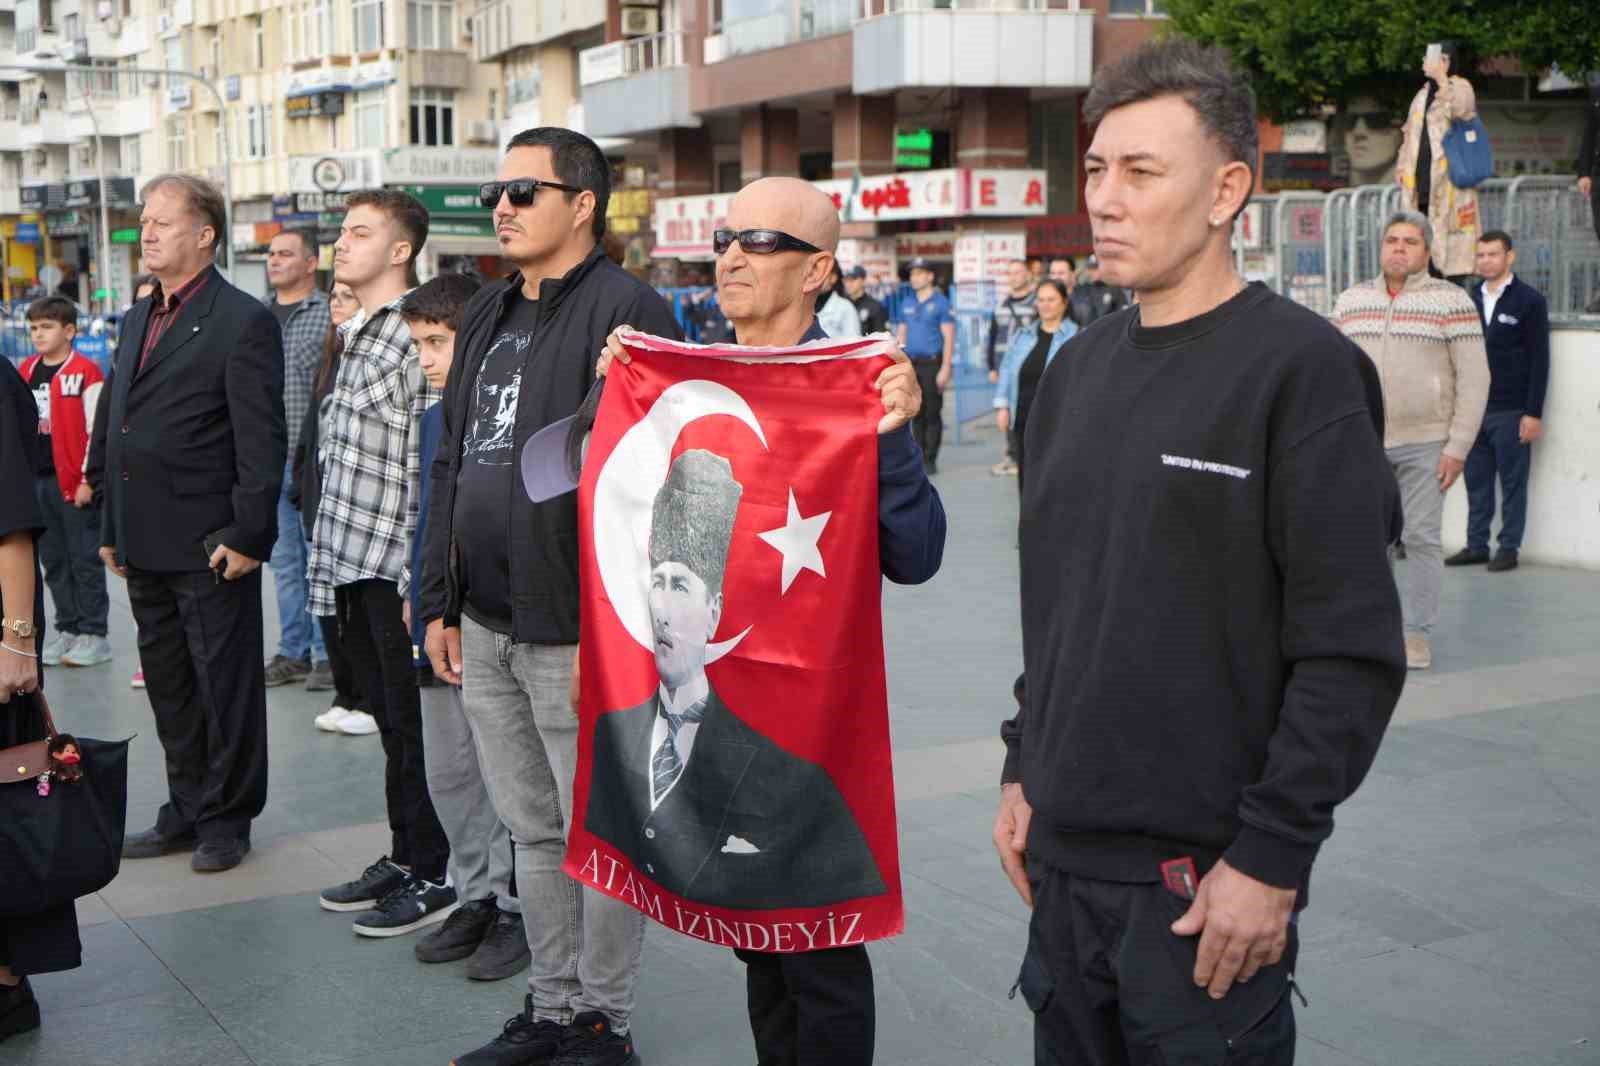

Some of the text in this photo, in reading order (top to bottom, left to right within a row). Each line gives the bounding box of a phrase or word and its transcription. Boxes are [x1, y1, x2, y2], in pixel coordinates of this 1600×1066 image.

[60, 373, 84, 397] W
[579, 848, 865, 951] ATAM İZİNDEYİZ
